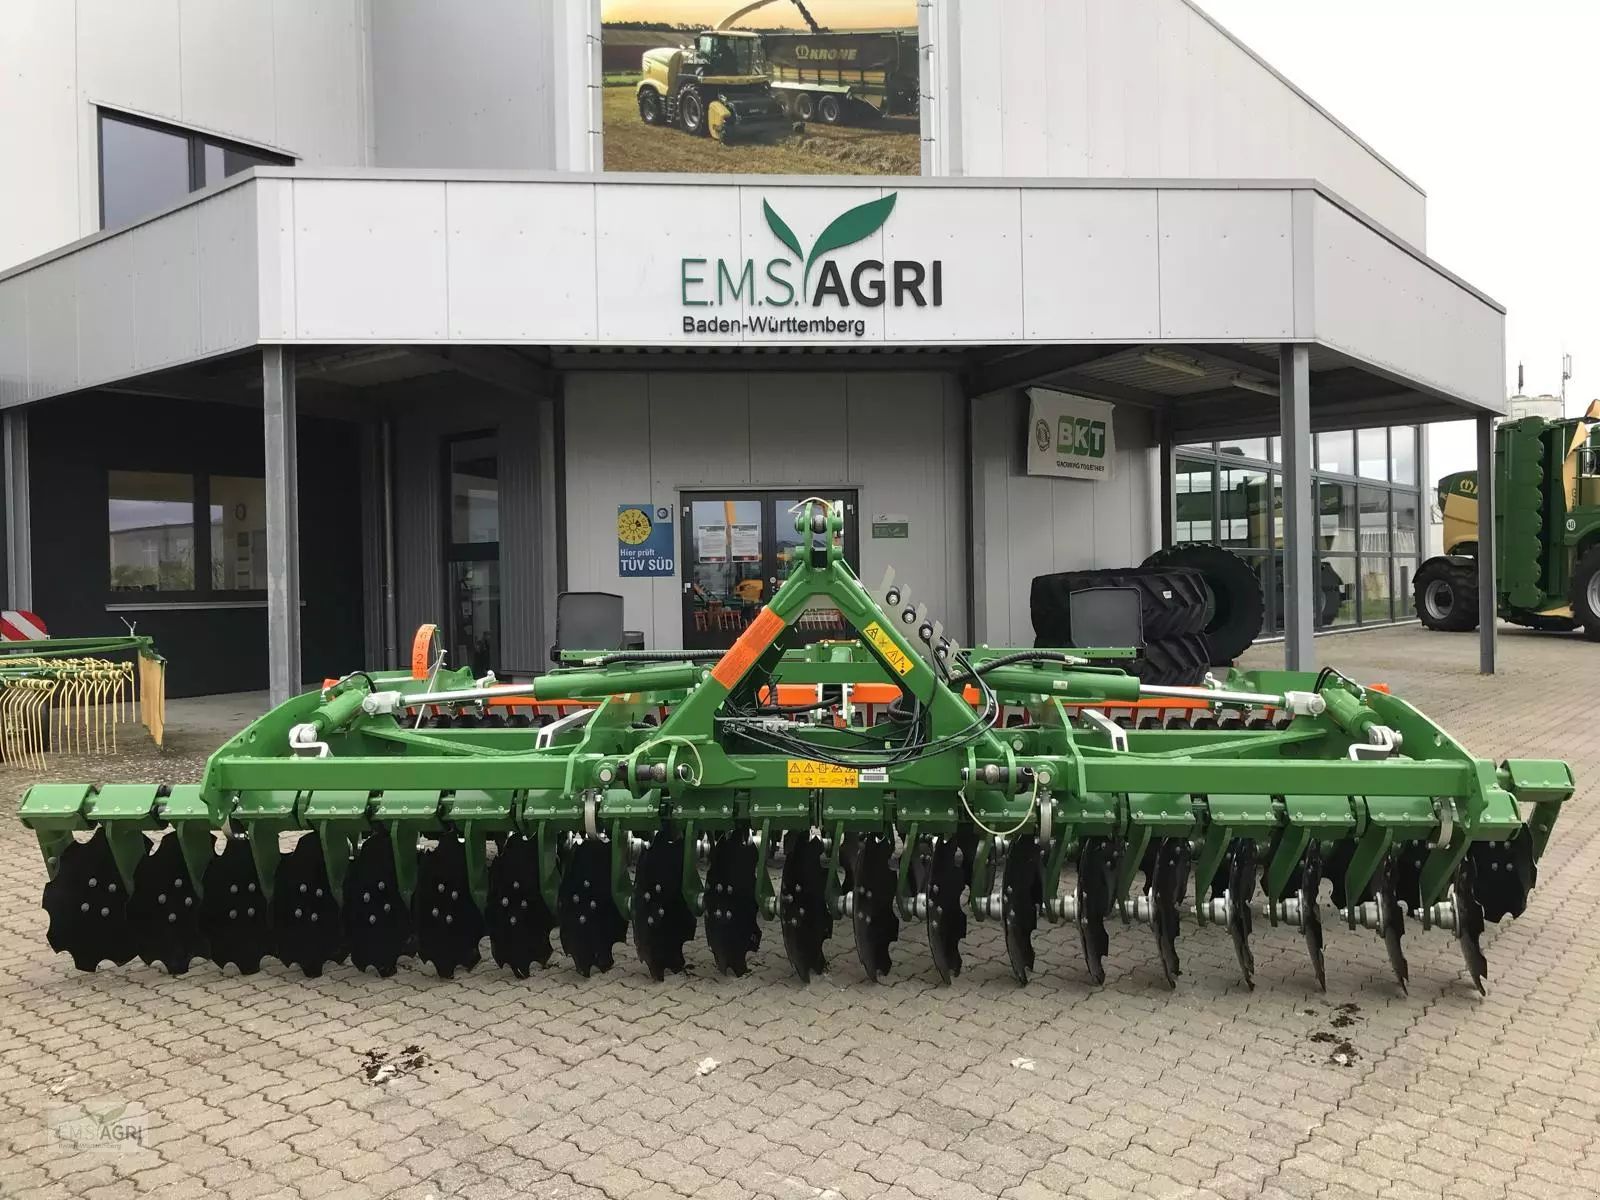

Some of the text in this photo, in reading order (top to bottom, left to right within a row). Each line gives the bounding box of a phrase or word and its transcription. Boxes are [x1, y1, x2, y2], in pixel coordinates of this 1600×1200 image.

[809, 48, 857, 60] KRONE
[682, 258, 942, 307] E.M.S. AGRI
[682, 315, 865, 336] Baden-Württemberg
[1058, 418, 1105, 455] BKT
[637, 549, 655, 558] prüft
[620, 557, 673, 571] TÜV SÜD
